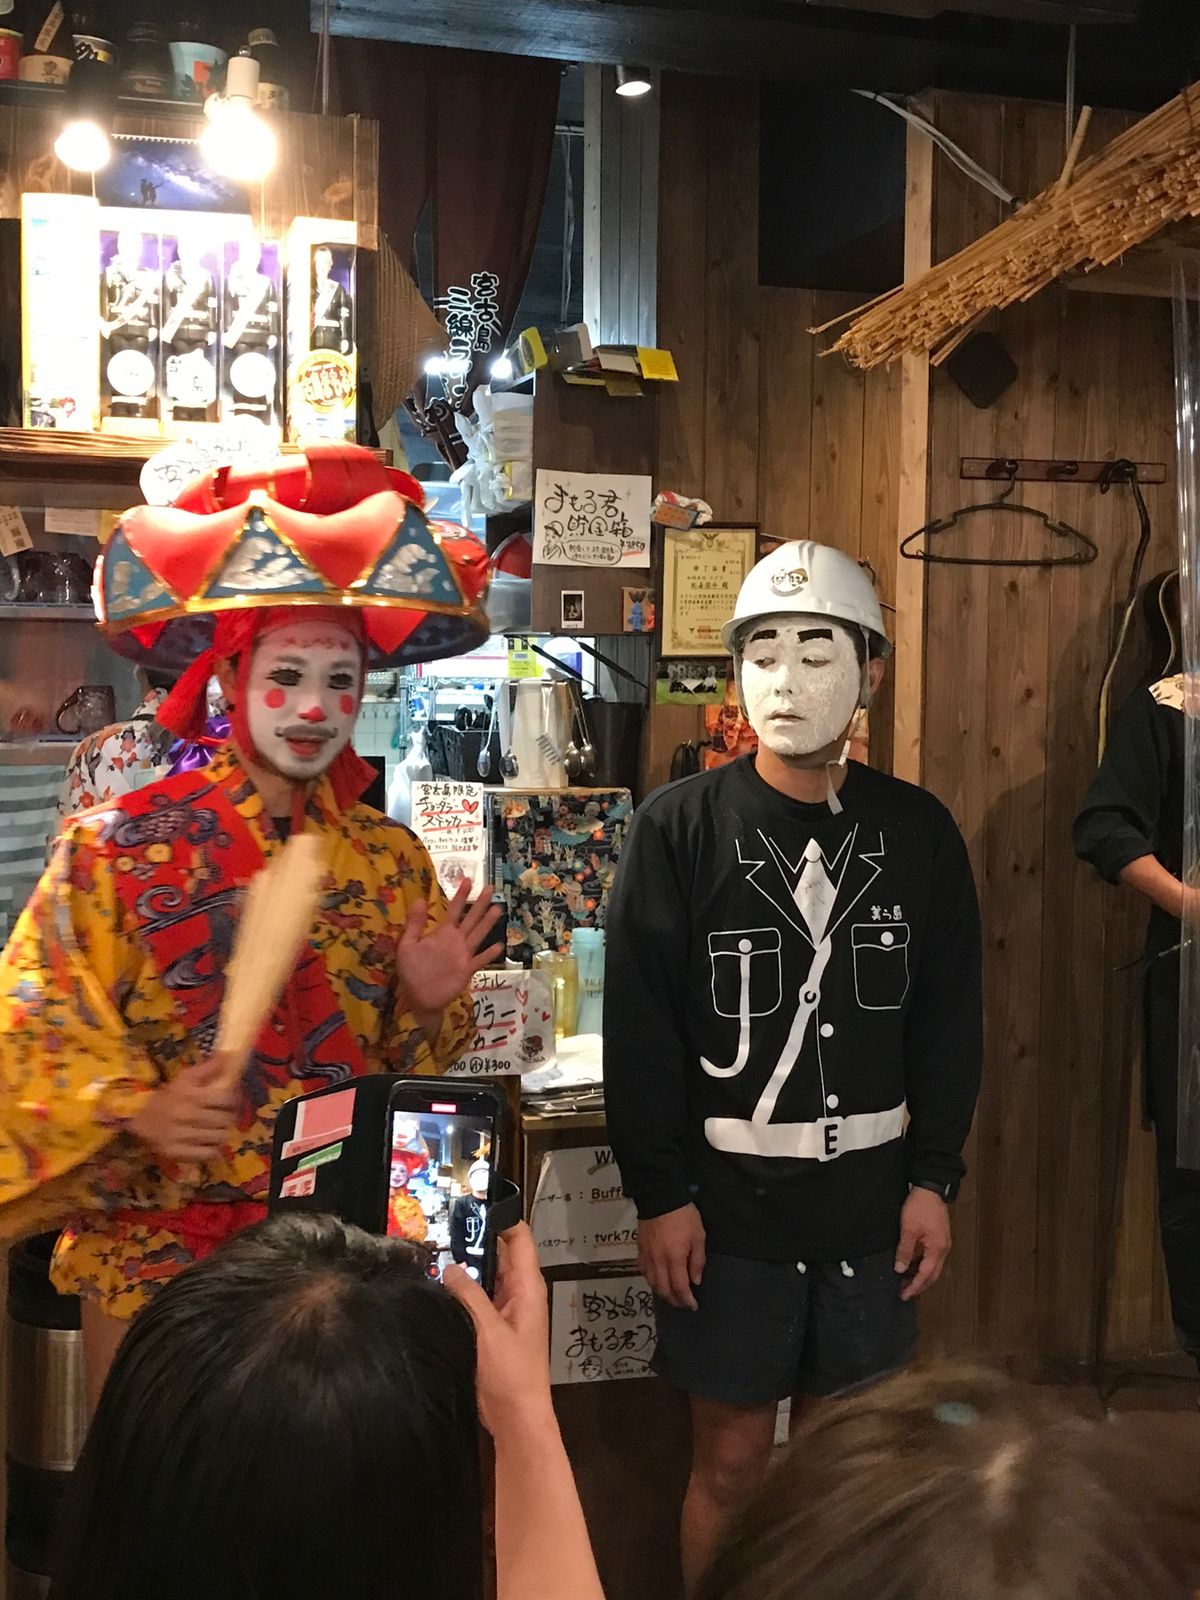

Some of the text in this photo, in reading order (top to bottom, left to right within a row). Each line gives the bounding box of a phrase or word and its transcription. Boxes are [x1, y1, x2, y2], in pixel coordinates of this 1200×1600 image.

[471, 271, 499, 353] 宮古島
[544, 483, 621, 518] まもる君
[567, 512, 634, 538] 貯金箱
[420, 783, 479, 798] 宮古島限定
[422, 812, 475, 828] ステッカー
[473, 1033, 508, 1051] カー
[449, 1060, 466, 1073] 00
[485, 1057, 511, 1073] ¥300
[594, 1150, 615, 1165] W
[537, 1193, 572, 1203] ーザー名
[591, 1186, 624, 1200] Buff
